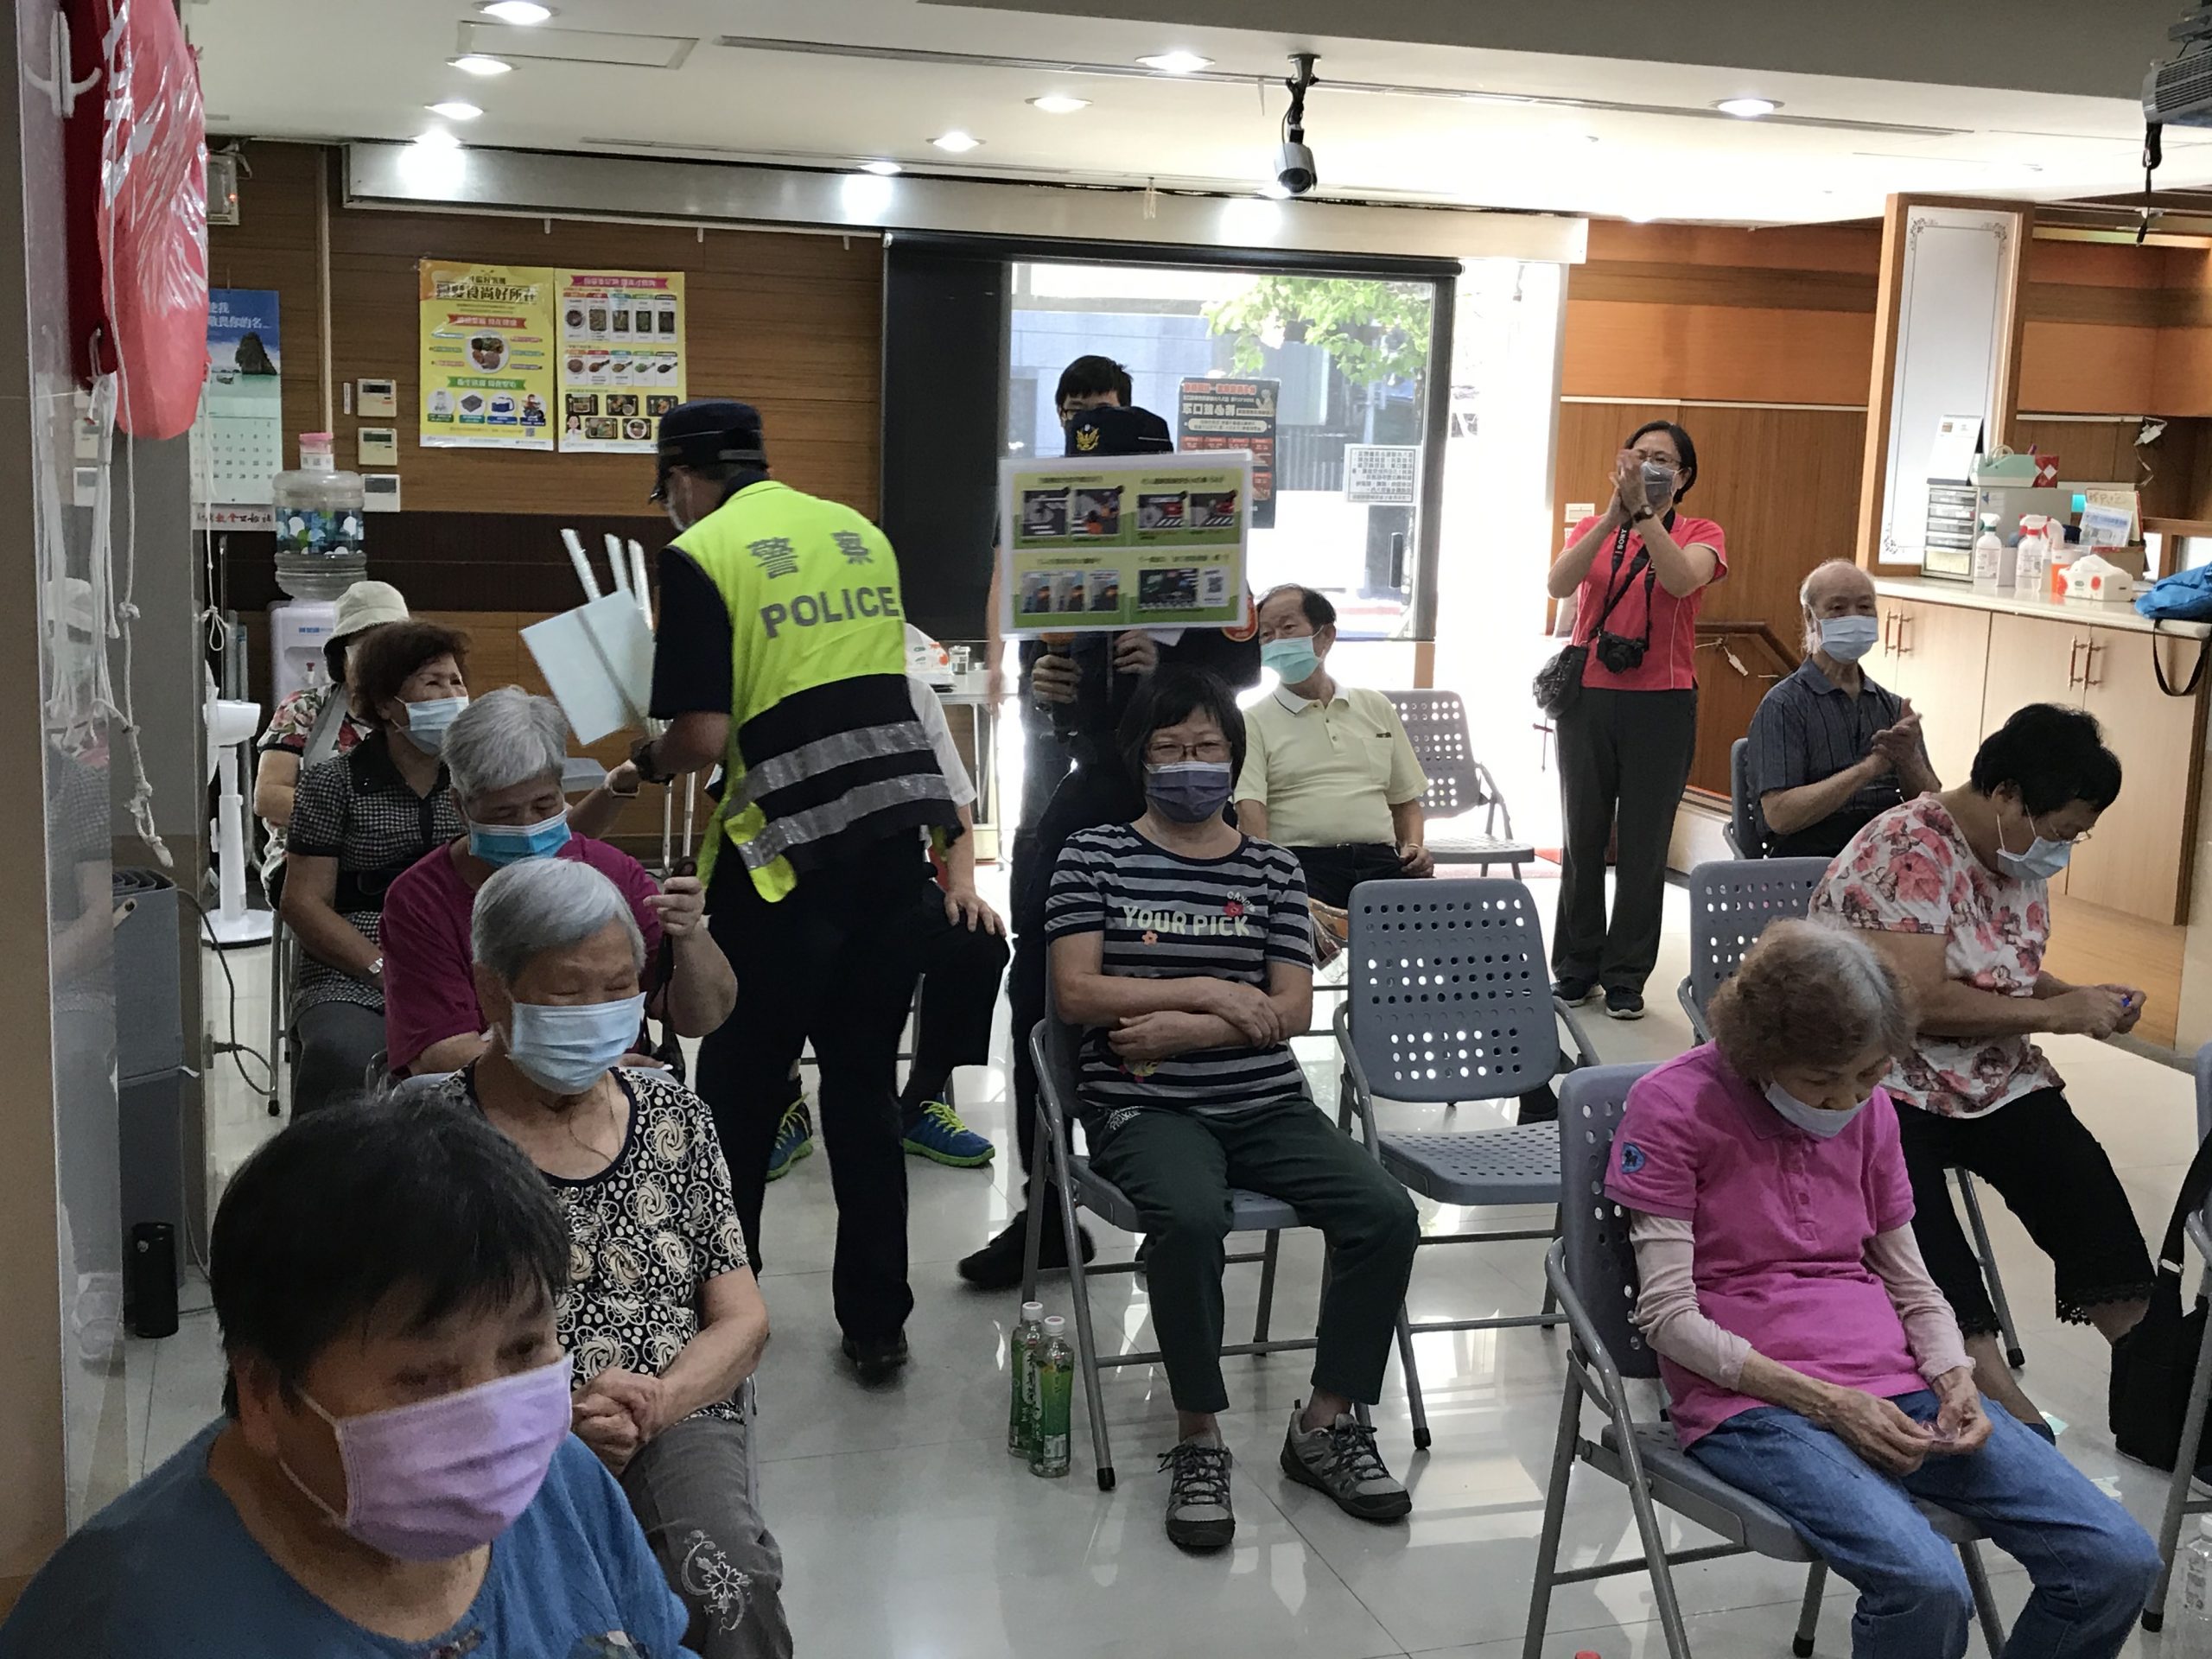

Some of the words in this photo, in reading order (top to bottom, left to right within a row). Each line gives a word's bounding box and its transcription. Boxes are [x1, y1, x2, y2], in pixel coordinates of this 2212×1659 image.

[746, 529, 874, 579] 警察
[1617, 529, 1627, 550] SONY
[760, 587, 899, 639] POLICE
[1122, 906, 1186, 935] YOUR
[1192, 914, 1250, 937] PICK
